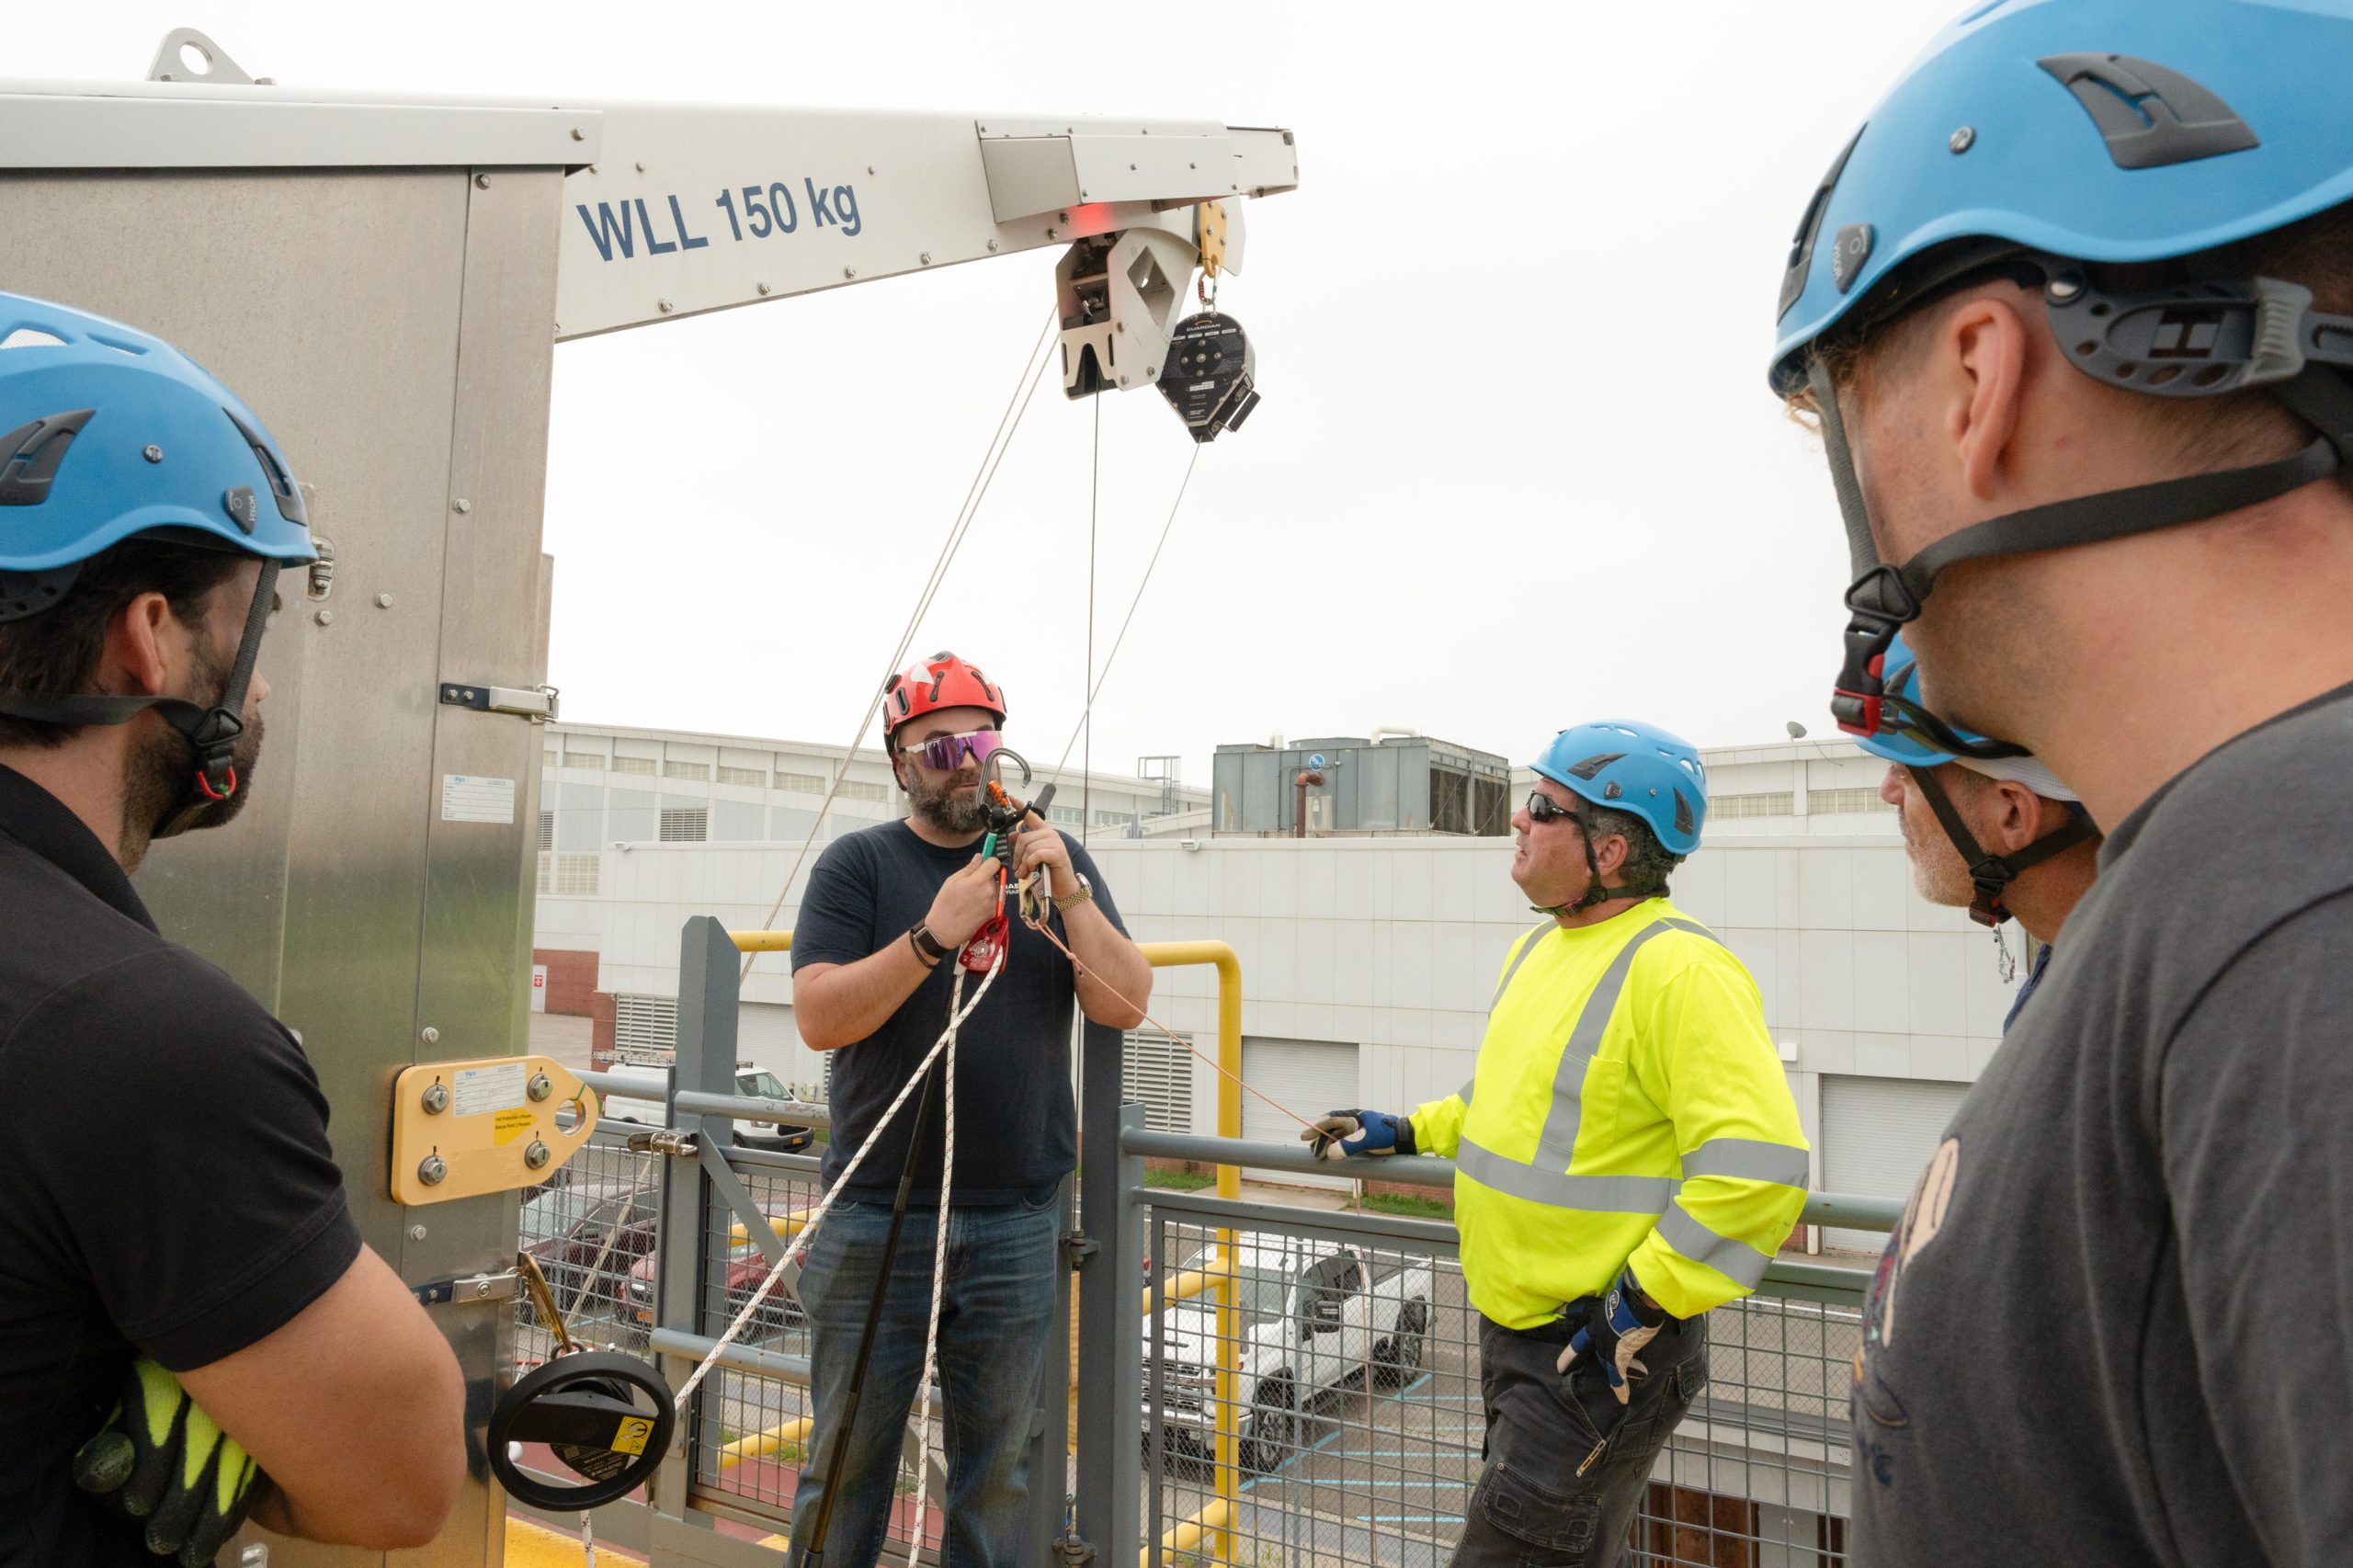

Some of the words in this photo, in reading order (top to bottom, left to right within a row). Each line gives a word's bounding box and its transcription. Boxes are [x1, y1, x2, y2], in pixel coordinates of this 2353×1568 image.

[576, 195, 710, 262] WLL
[715, 182, 798, 242] 150
[804, 177, 862, 237] kg
[1186, 324, 1221, 332] GUARDIAN
[248, 495, 256, 521] VISOR
